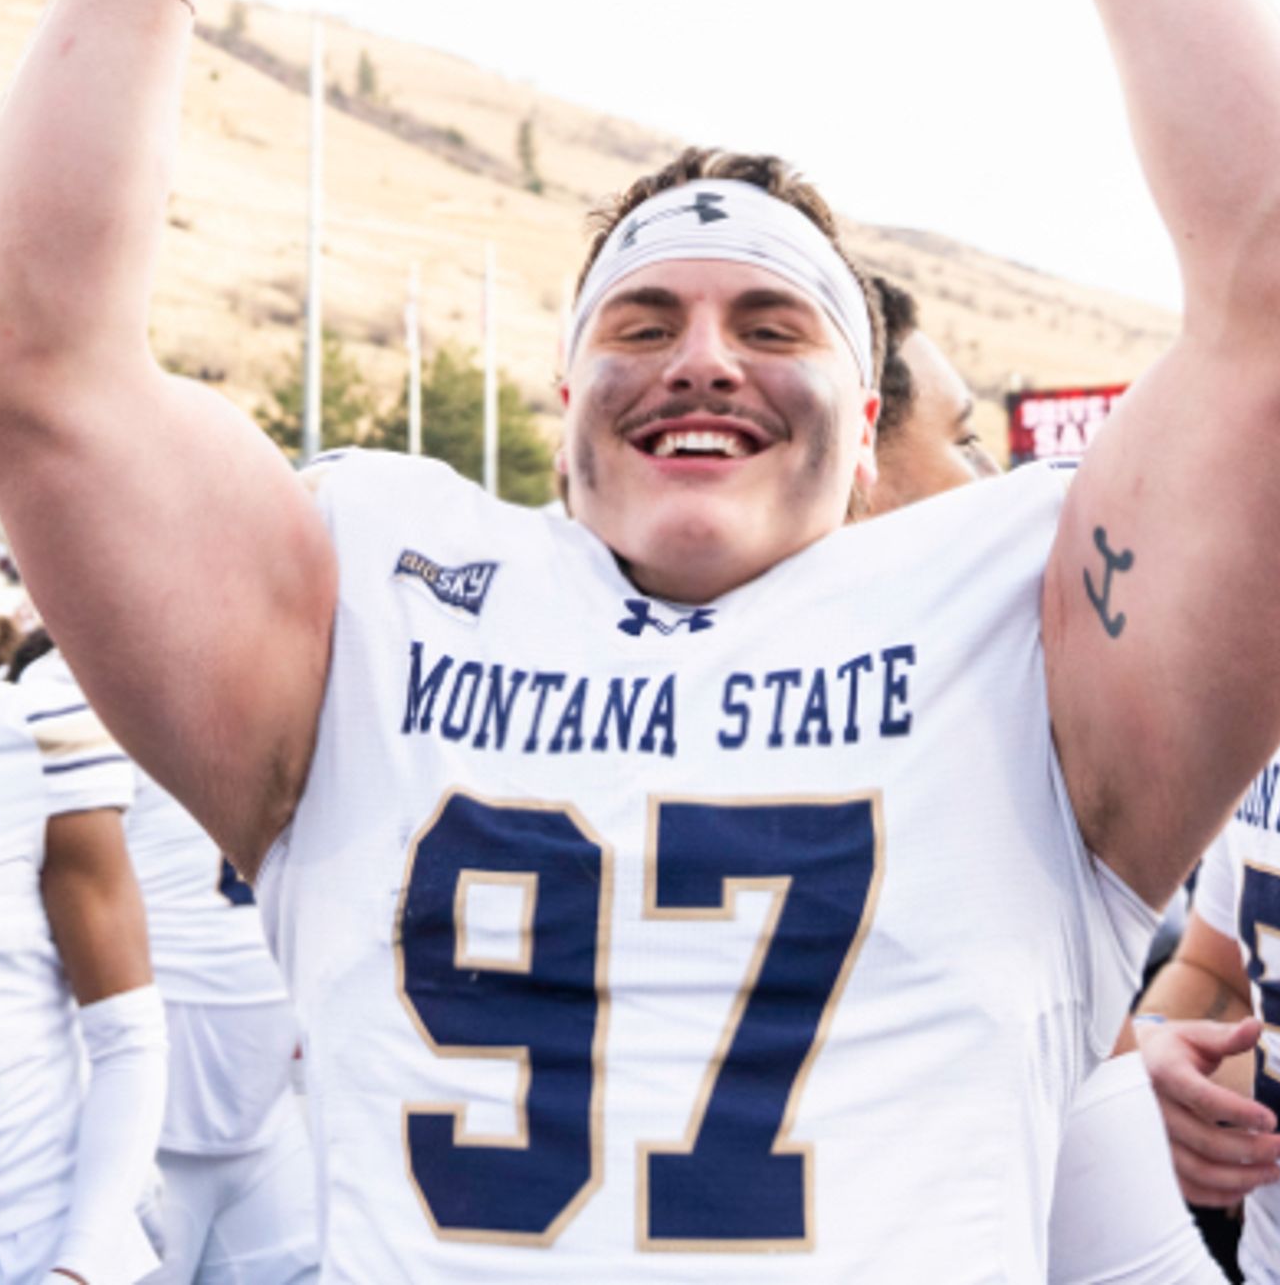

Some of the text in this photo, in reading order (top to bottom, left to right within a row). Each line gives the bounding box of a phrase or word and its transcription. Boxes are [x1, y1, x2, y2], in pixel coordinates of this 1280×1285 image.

[401, 641, 918, 758] MONTANA STATE
[393, 785, 886, 1253] 97
